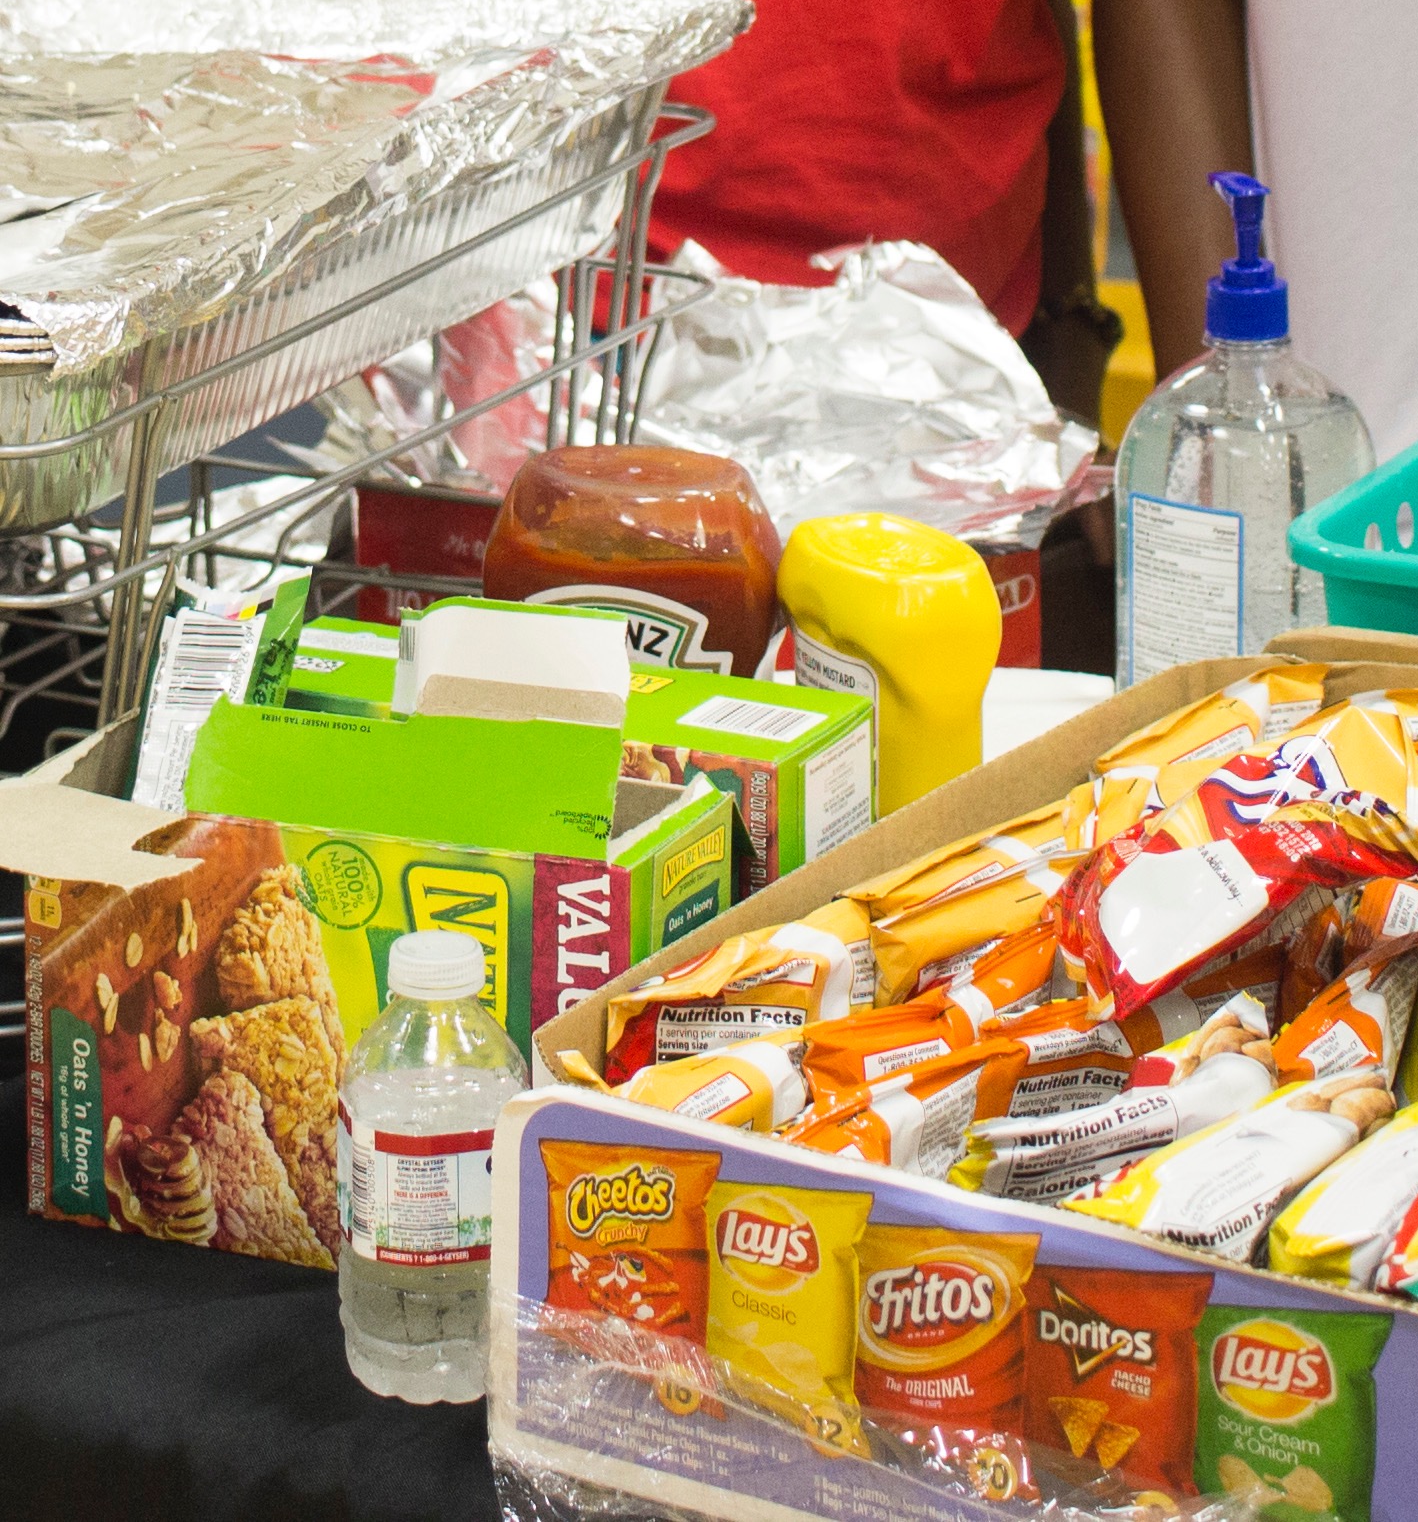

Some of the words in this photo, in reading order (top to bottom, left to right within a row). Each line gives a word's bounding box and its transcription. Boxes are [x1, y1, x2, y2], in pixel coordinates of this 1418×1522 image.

[823, 664, 855, 688] MUSTARD
[261, 713, 281, 722] HERE
[283, 716, 299, 725] TAB
[301, 717, 330, 729] INSERT
[332, 721, 358, 732] CLOSE
[359, 724, 371, 734] TO
[665, 849, 697, 889] NATURE
[313, 872, 328, 902] OATS
[328, 851, 351, 917] NATURAL
[341, 856, 365, 908] 100%
[668, 915, 684, 932] Oats
[692, 897, 713, 916] Honey
[661, 1007, 746, 1025] Nutrition
[30, 1025, 44, 1064] POUCHES
[658, 1039, 690, 1051] Serving
[692, 1040, 709, 1050] size
[659, 1029, 664, 1039] 1
[666, 1029, 700, 1041] serving
[701, 1029, 717, 1041] per
[719, 1029, 761, 1040] container
[73, 1038, 91, 1091] Oats
[878, 1051, 906, 1066] Questions
[1016, 1074, 1079, 1095] Nutrition
[1082, 1070, 1128, 1089] Facts
[75, 1101, 92, 1119] 'n
[1009, 1107, 1041, 1119] Serving
[1042, 1105, 1060, 1115] size
[1019, 1096, 1048, 1109] serving
[1049, 1095, 1061, 1106] per
[1062, 1091, 1103, 1103] container
[1020, 1115, 1113, 1148] Nutrition
[1114, 1094, 1168, 1124] Facts
[1016, 1156, 1068, 1170] Serving
[1118, 1127, 1173, 1146] package
[1095, 1126, 1147, 1146] container
[72, 1126, 92, 1197] Honey
[397, 1158, 421, 1166] CRYSTAL
[395, 1190, 408, 1198] THERE
[1007, 1174, 1102, 1199] Calories
[567, 1166, 674, 1234] Cheetos
[597, 1222, 647, 1245] Crunchy
[722, 1211, 811, 1267] Lay's
[1167, 1212, 1251, 1248] Nutrition
[732, 1290, 797, 1326] Classic
[867, 1265, 994, 1337] Fritos
[907, 1329, 945, 1340] BRAND
[1039, 1310, 1152, 1360] Doritos
[1114, 1369, 1151, 1385] NACHO
[1220, 1336, 1322, 1393] Lay's
[663, 1385, 692, 1406] 16
[885, 1376, 902, 1392] The
[905, 1374, 974, 1399] ORIGINAL
[1111, 1379, 1151, 1396] CHEESE
[925, 1398, 942, 1408] CHIPS
[816, 1416, 842, 1446] 12
[1218, 1415, 1255, 1437] Sour
[1259, 1425, 1321, 1457] Cream
[1234, 1436, 1245, 1450] &
[1248, 1439, 1299, 1466] Onion
